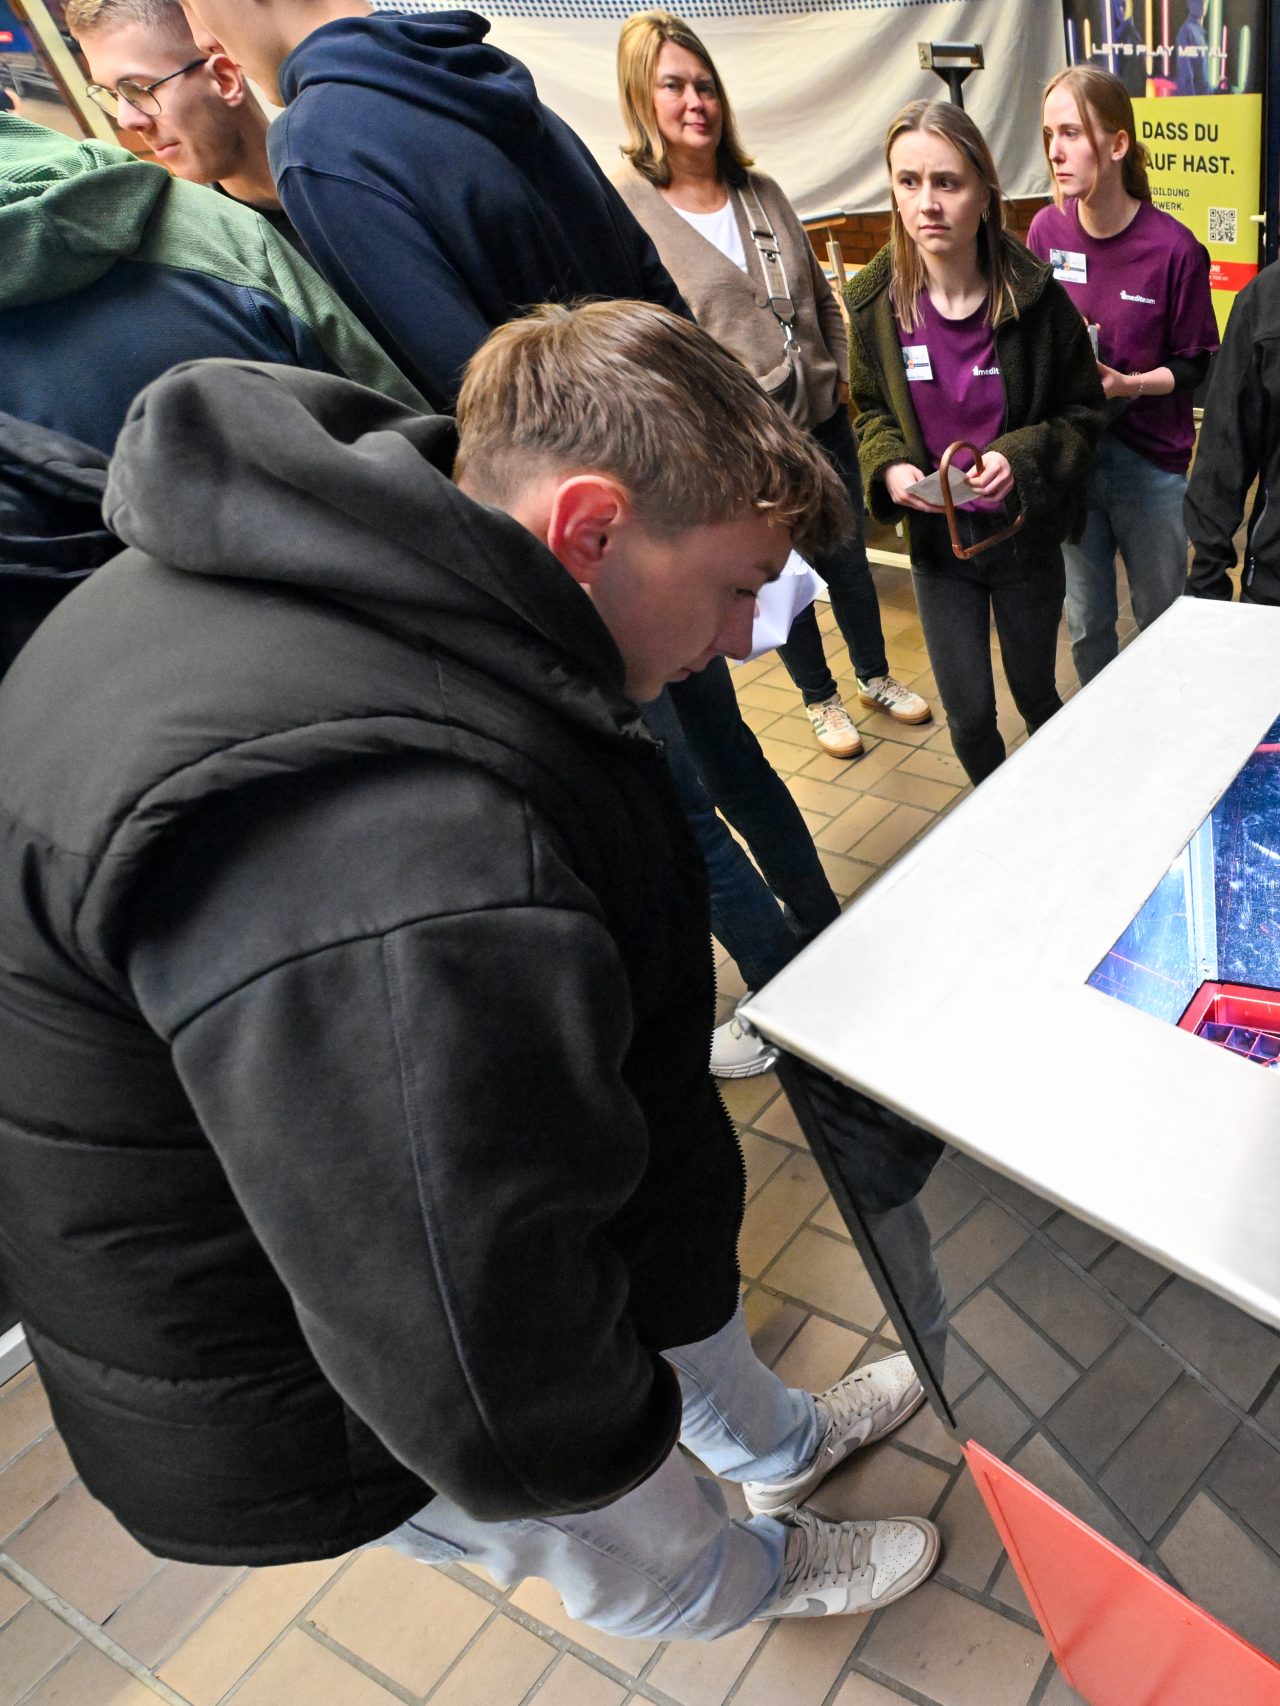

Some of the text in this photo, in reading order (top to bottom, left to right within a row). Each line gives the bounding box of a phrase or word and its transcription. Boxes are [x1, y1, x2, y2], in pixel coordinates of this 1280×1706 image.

[1092, 43, 1228, 58] LET'S PLAY METAL
[1142, 121, 1218, 142] DASS DU
[1183, 154, 1235, 175] HAST.
